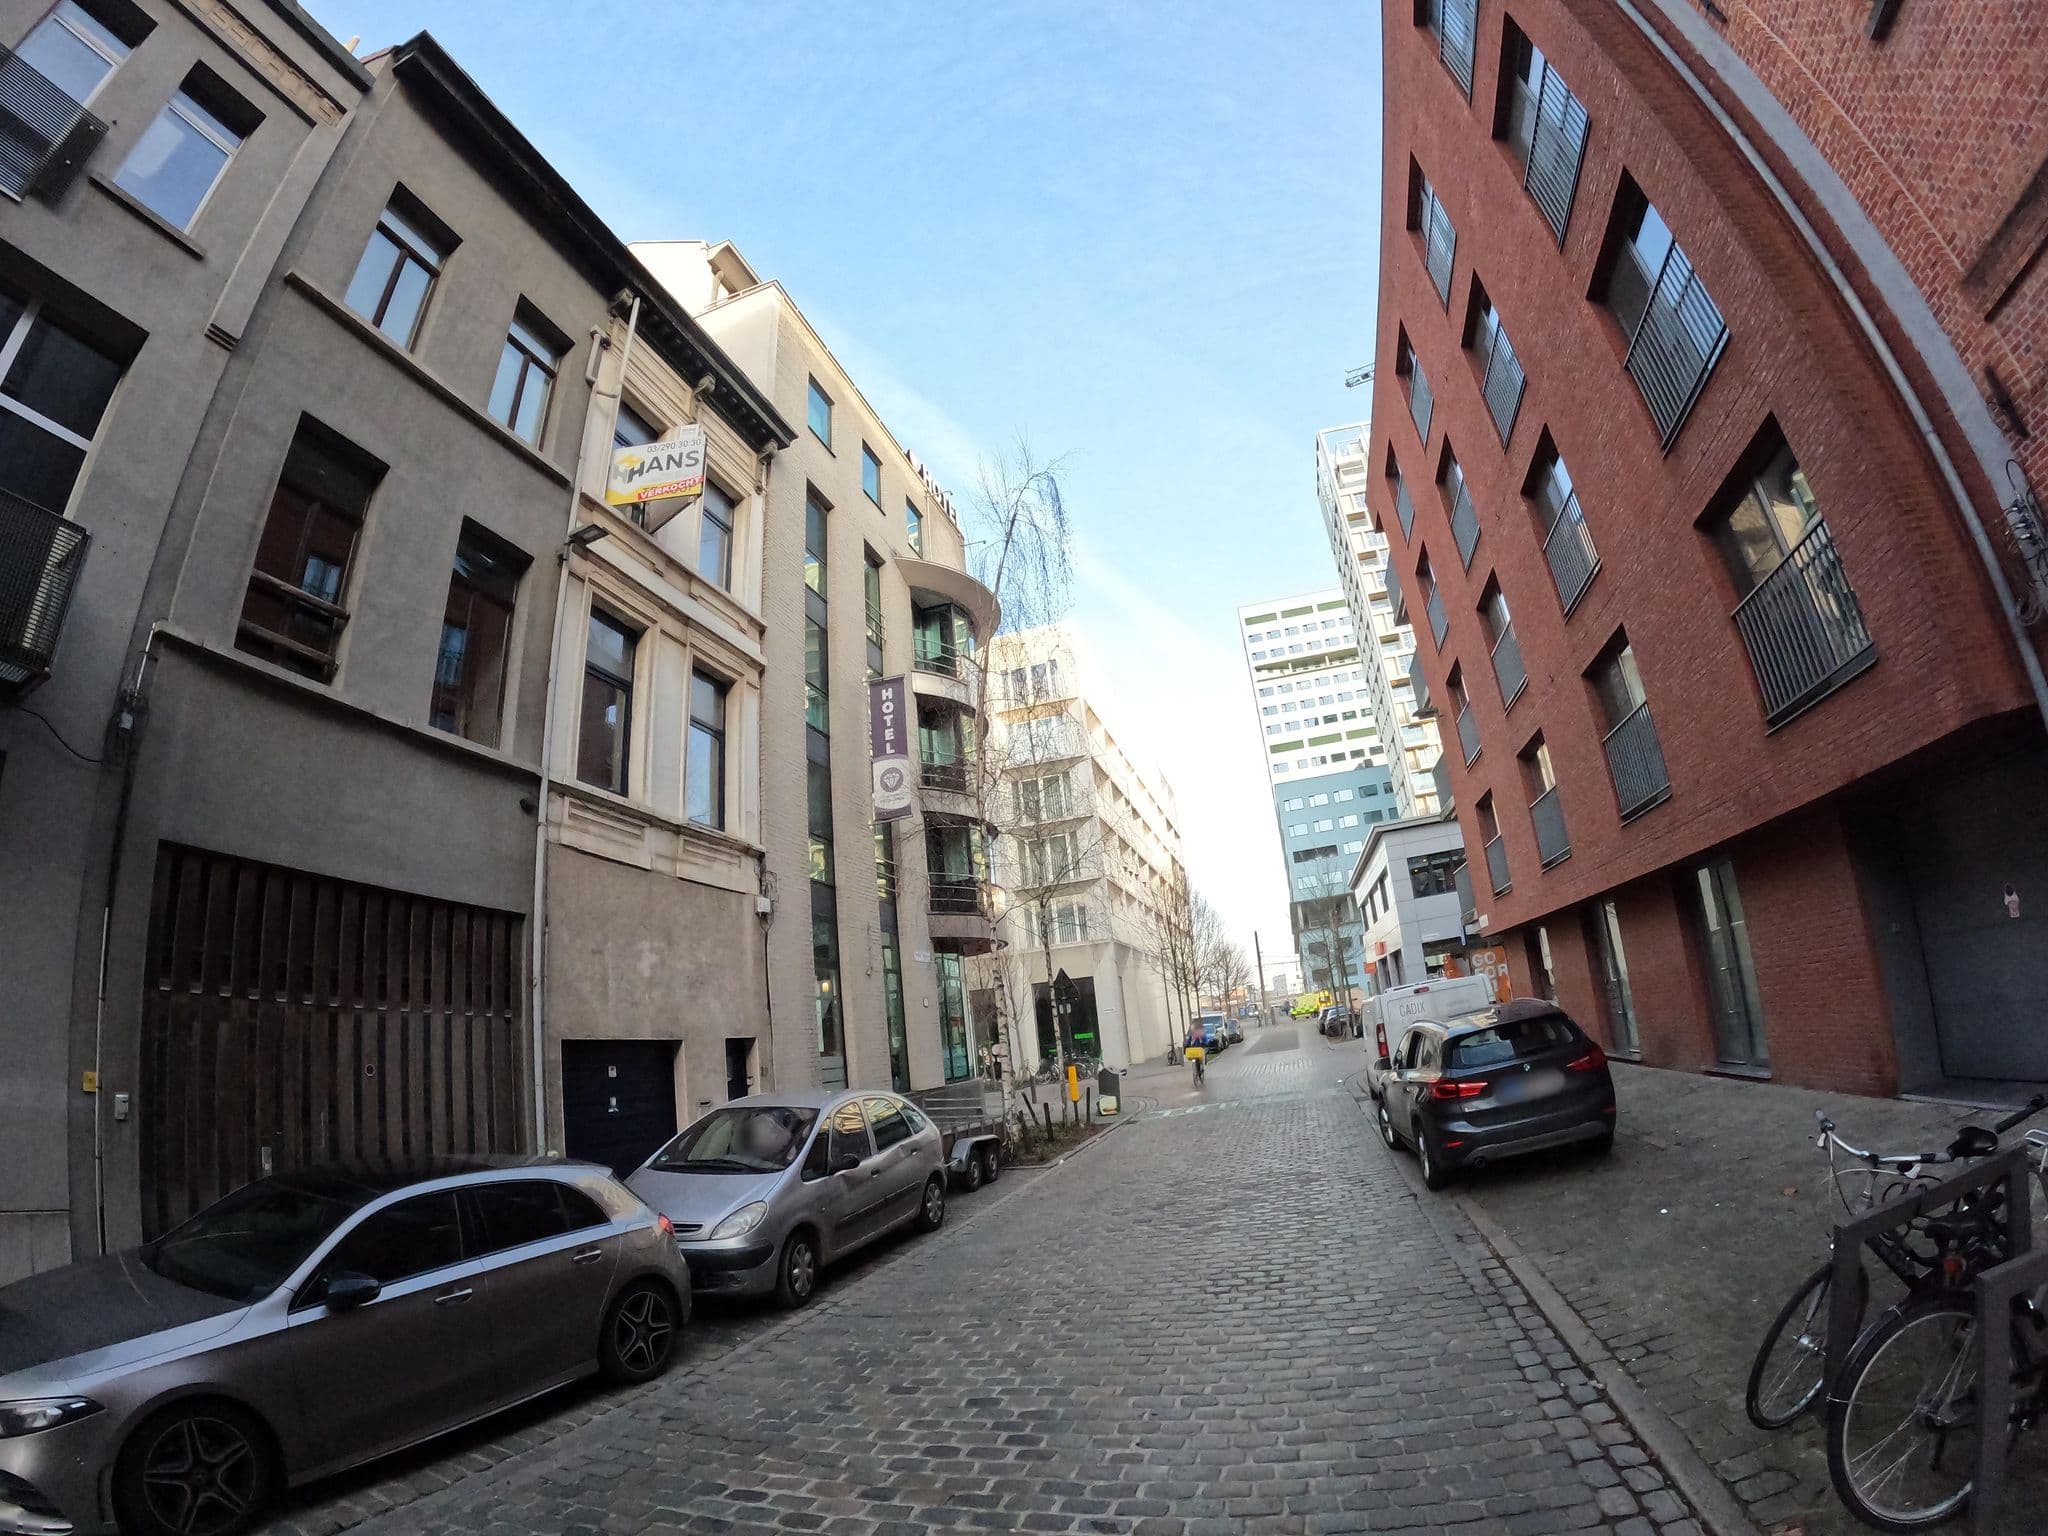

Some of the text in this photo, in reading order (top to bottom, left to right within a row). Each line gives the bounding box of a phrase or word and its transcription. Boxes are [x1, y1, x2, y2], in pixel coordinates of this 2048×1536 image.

[647, 442, 676, 453] 03/290
[627, 450, 700, 484] HANS
[640, 476, 701, 499] VERKOCHT
[881, 687, 895, 755] HOTEL
[1472, 951, 1496, 967] GO
